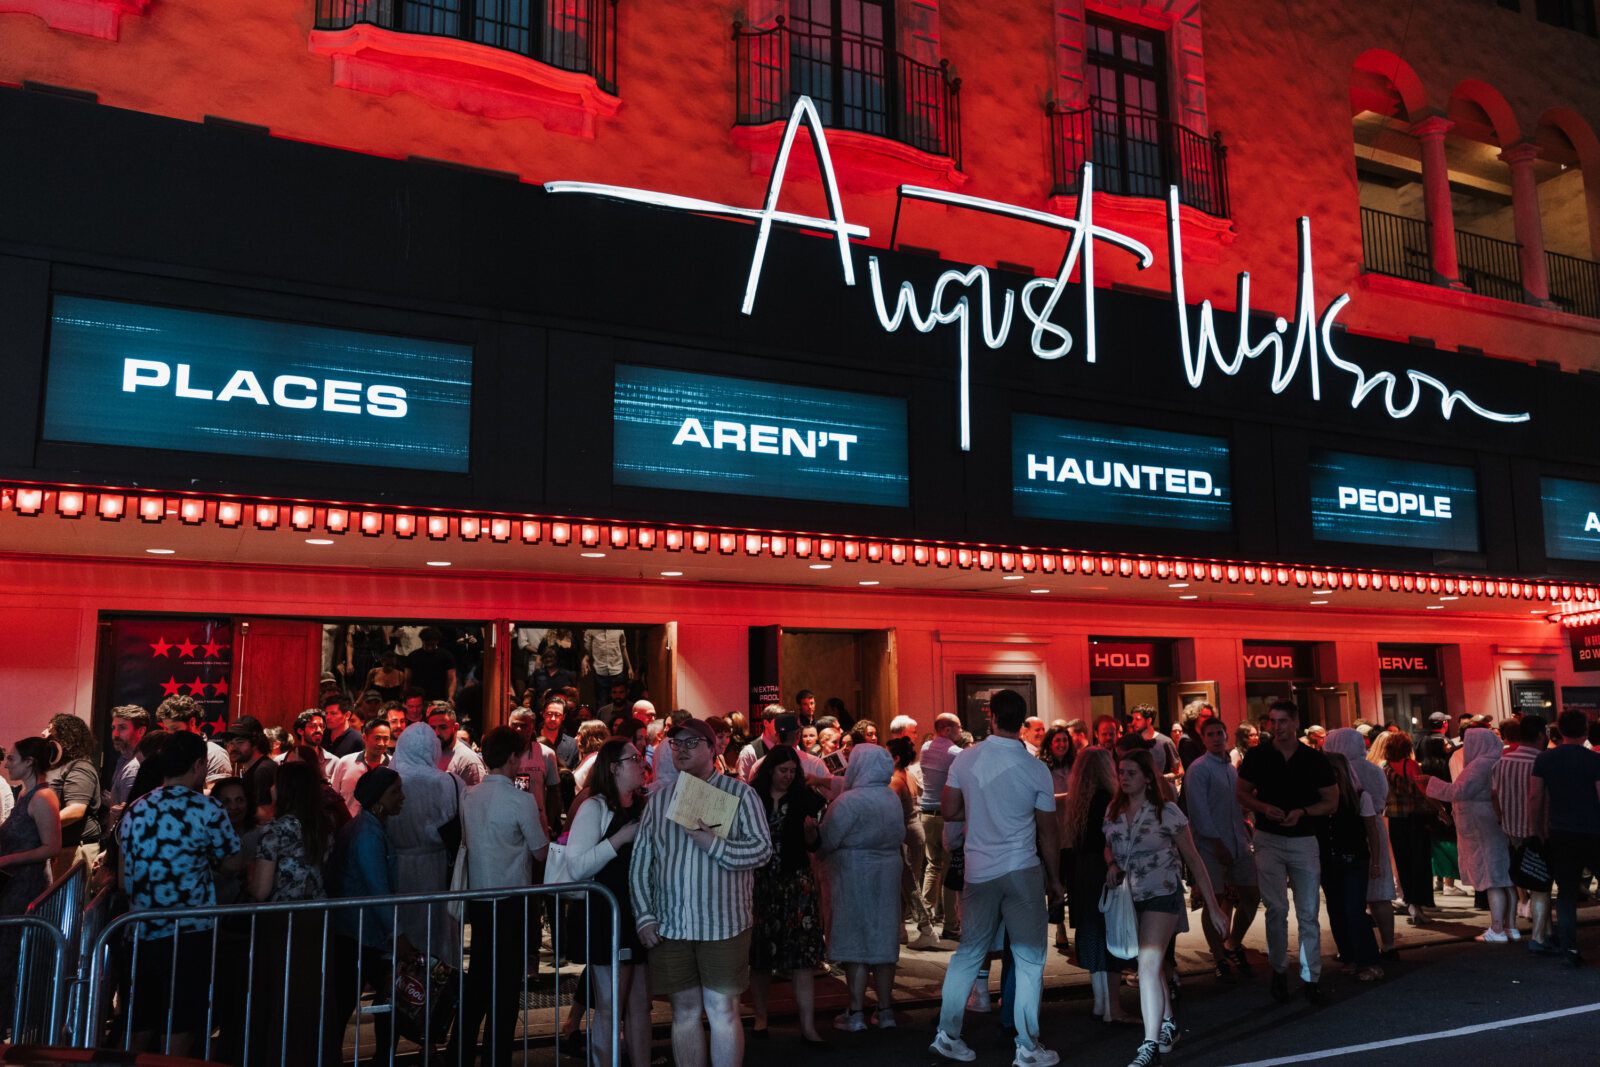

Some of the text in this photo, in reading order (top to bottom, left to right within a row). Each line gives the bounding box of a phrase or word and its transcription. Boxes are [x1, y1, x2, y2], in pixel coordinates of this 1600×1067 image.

[544, 94, 1531, 451] August Wilson
[122, 358, 408, 418] PLACES
[671, 417, 858, 462] AREN'T
[1027, 454, 1222, 497] HAUNTED.
[1337, 486, 1452, 520] PEOPLE
[1095, 653, 1150, 667] HOLD
[1243, 655, 1293, 669] YOUR
[1579, 649, 1591, 660] 20
